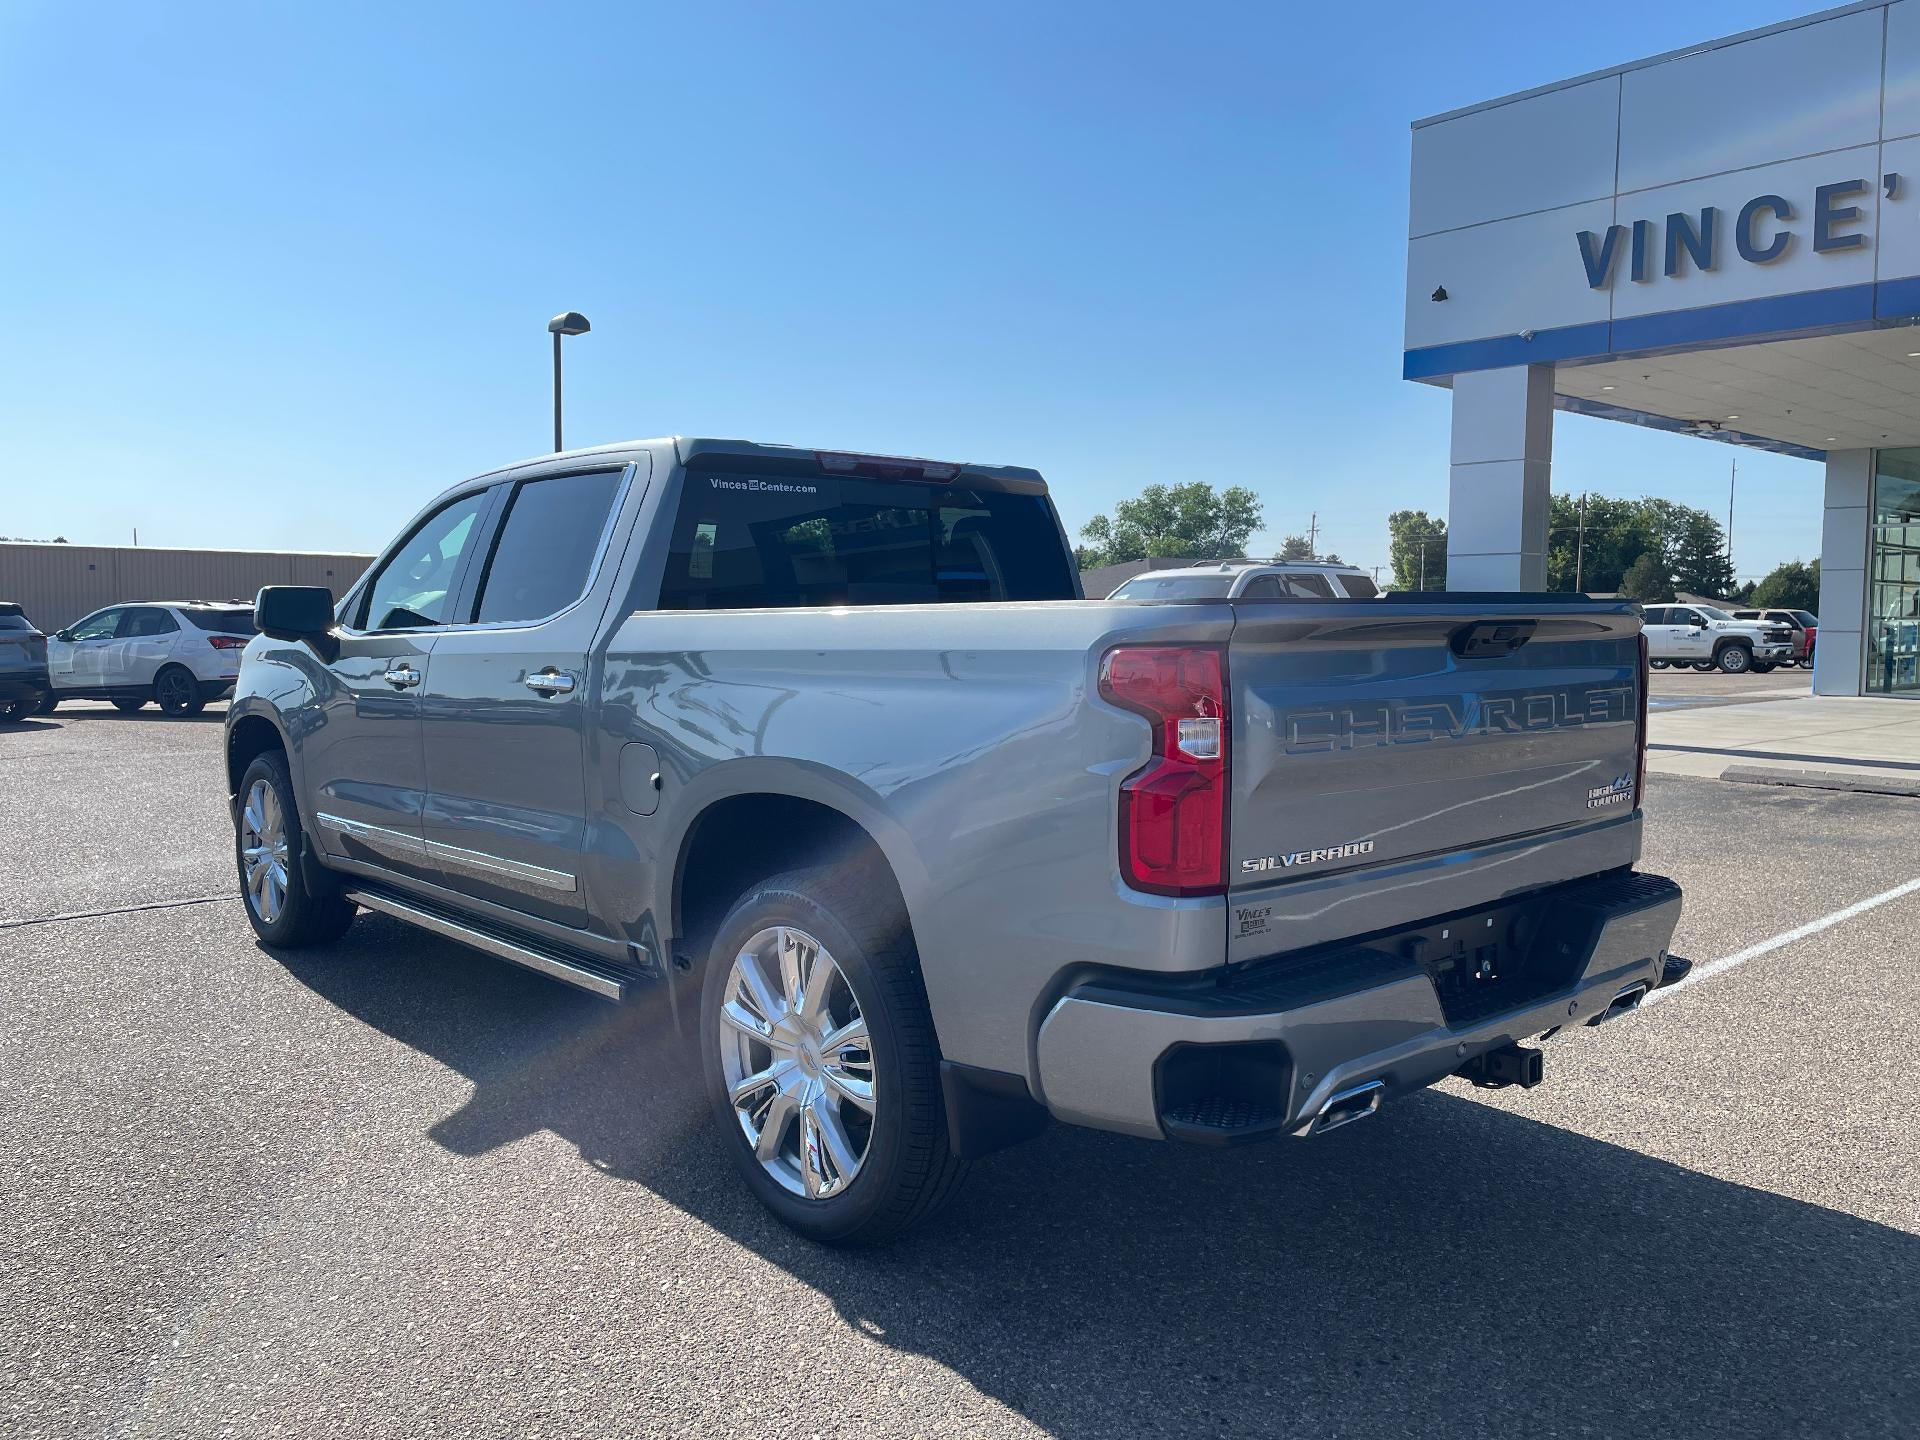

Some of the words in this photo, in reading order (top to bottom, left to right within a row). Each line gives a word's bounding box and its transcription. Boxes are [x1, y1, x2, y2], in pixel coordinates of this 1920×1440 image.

[1576, 172, 1903, 290] VINCE'
[1285, 687, 1633, 755] CHEVROLET
[1587, 791, 1632, 808] COUNTRY
[1241, 840, 1374, 872] SILVERADO
